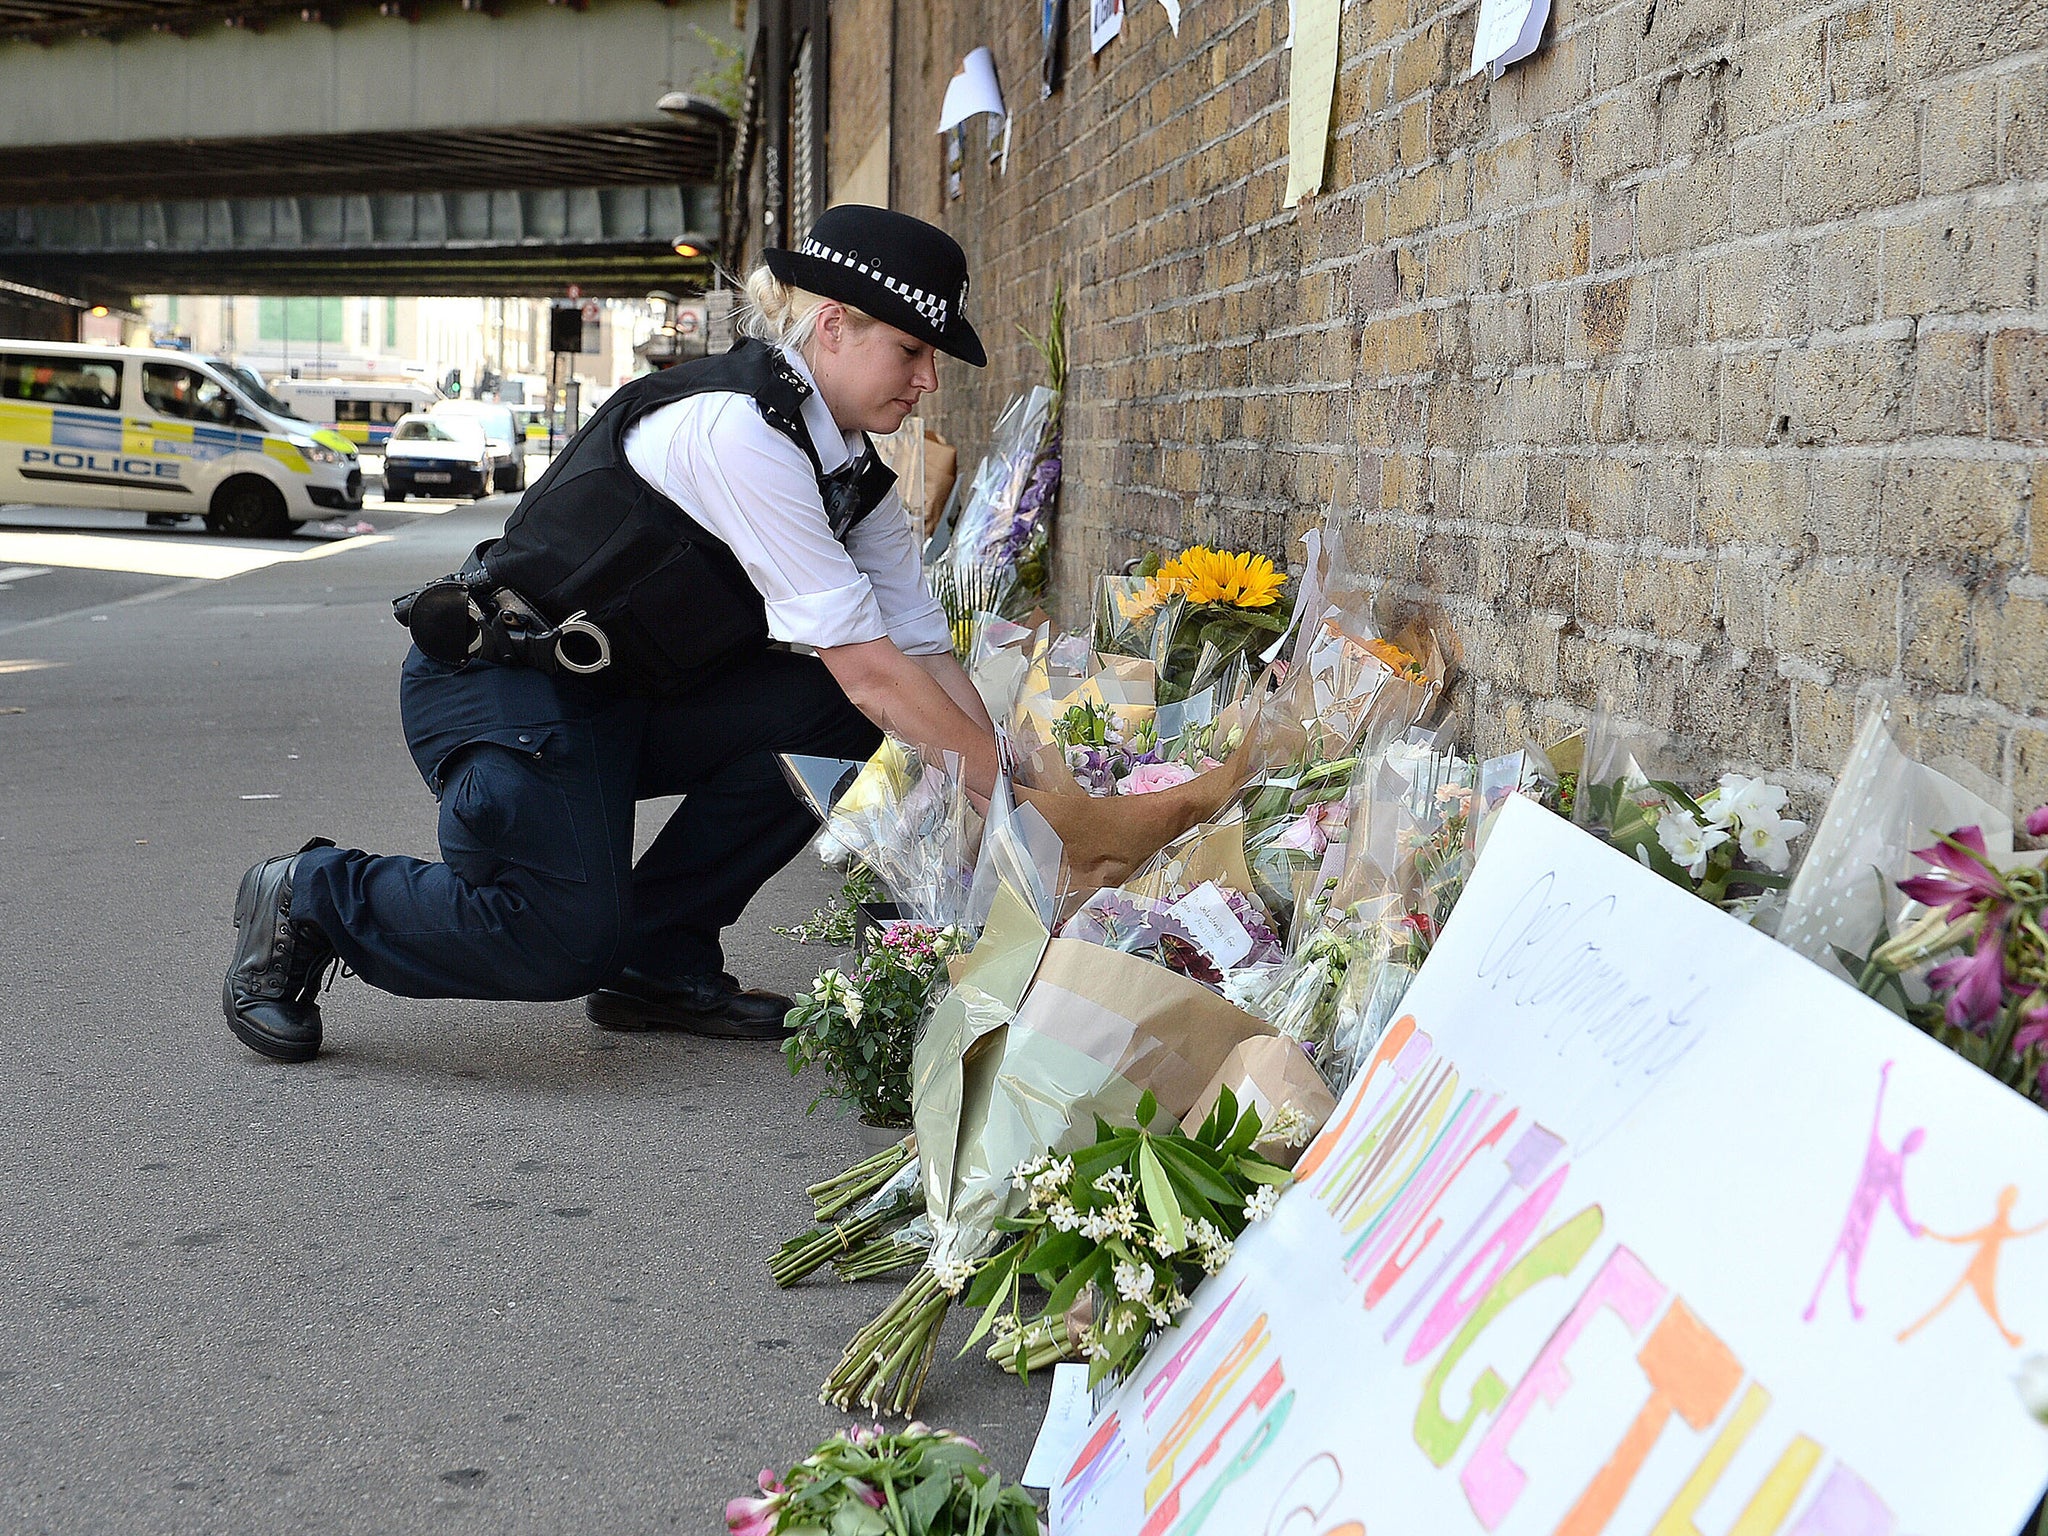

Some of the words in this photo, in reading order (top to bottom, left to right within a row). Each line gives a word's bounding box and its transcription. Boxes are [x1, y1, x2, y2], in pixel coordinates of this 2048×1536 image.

[22, 449, 181, 479] POLICE
[1293, 1013, 1521, 1312] STANDING
[1138, 1275, 1297, 1536] ABLER
[1381, 1120, 1897, 1536] TOGETH
